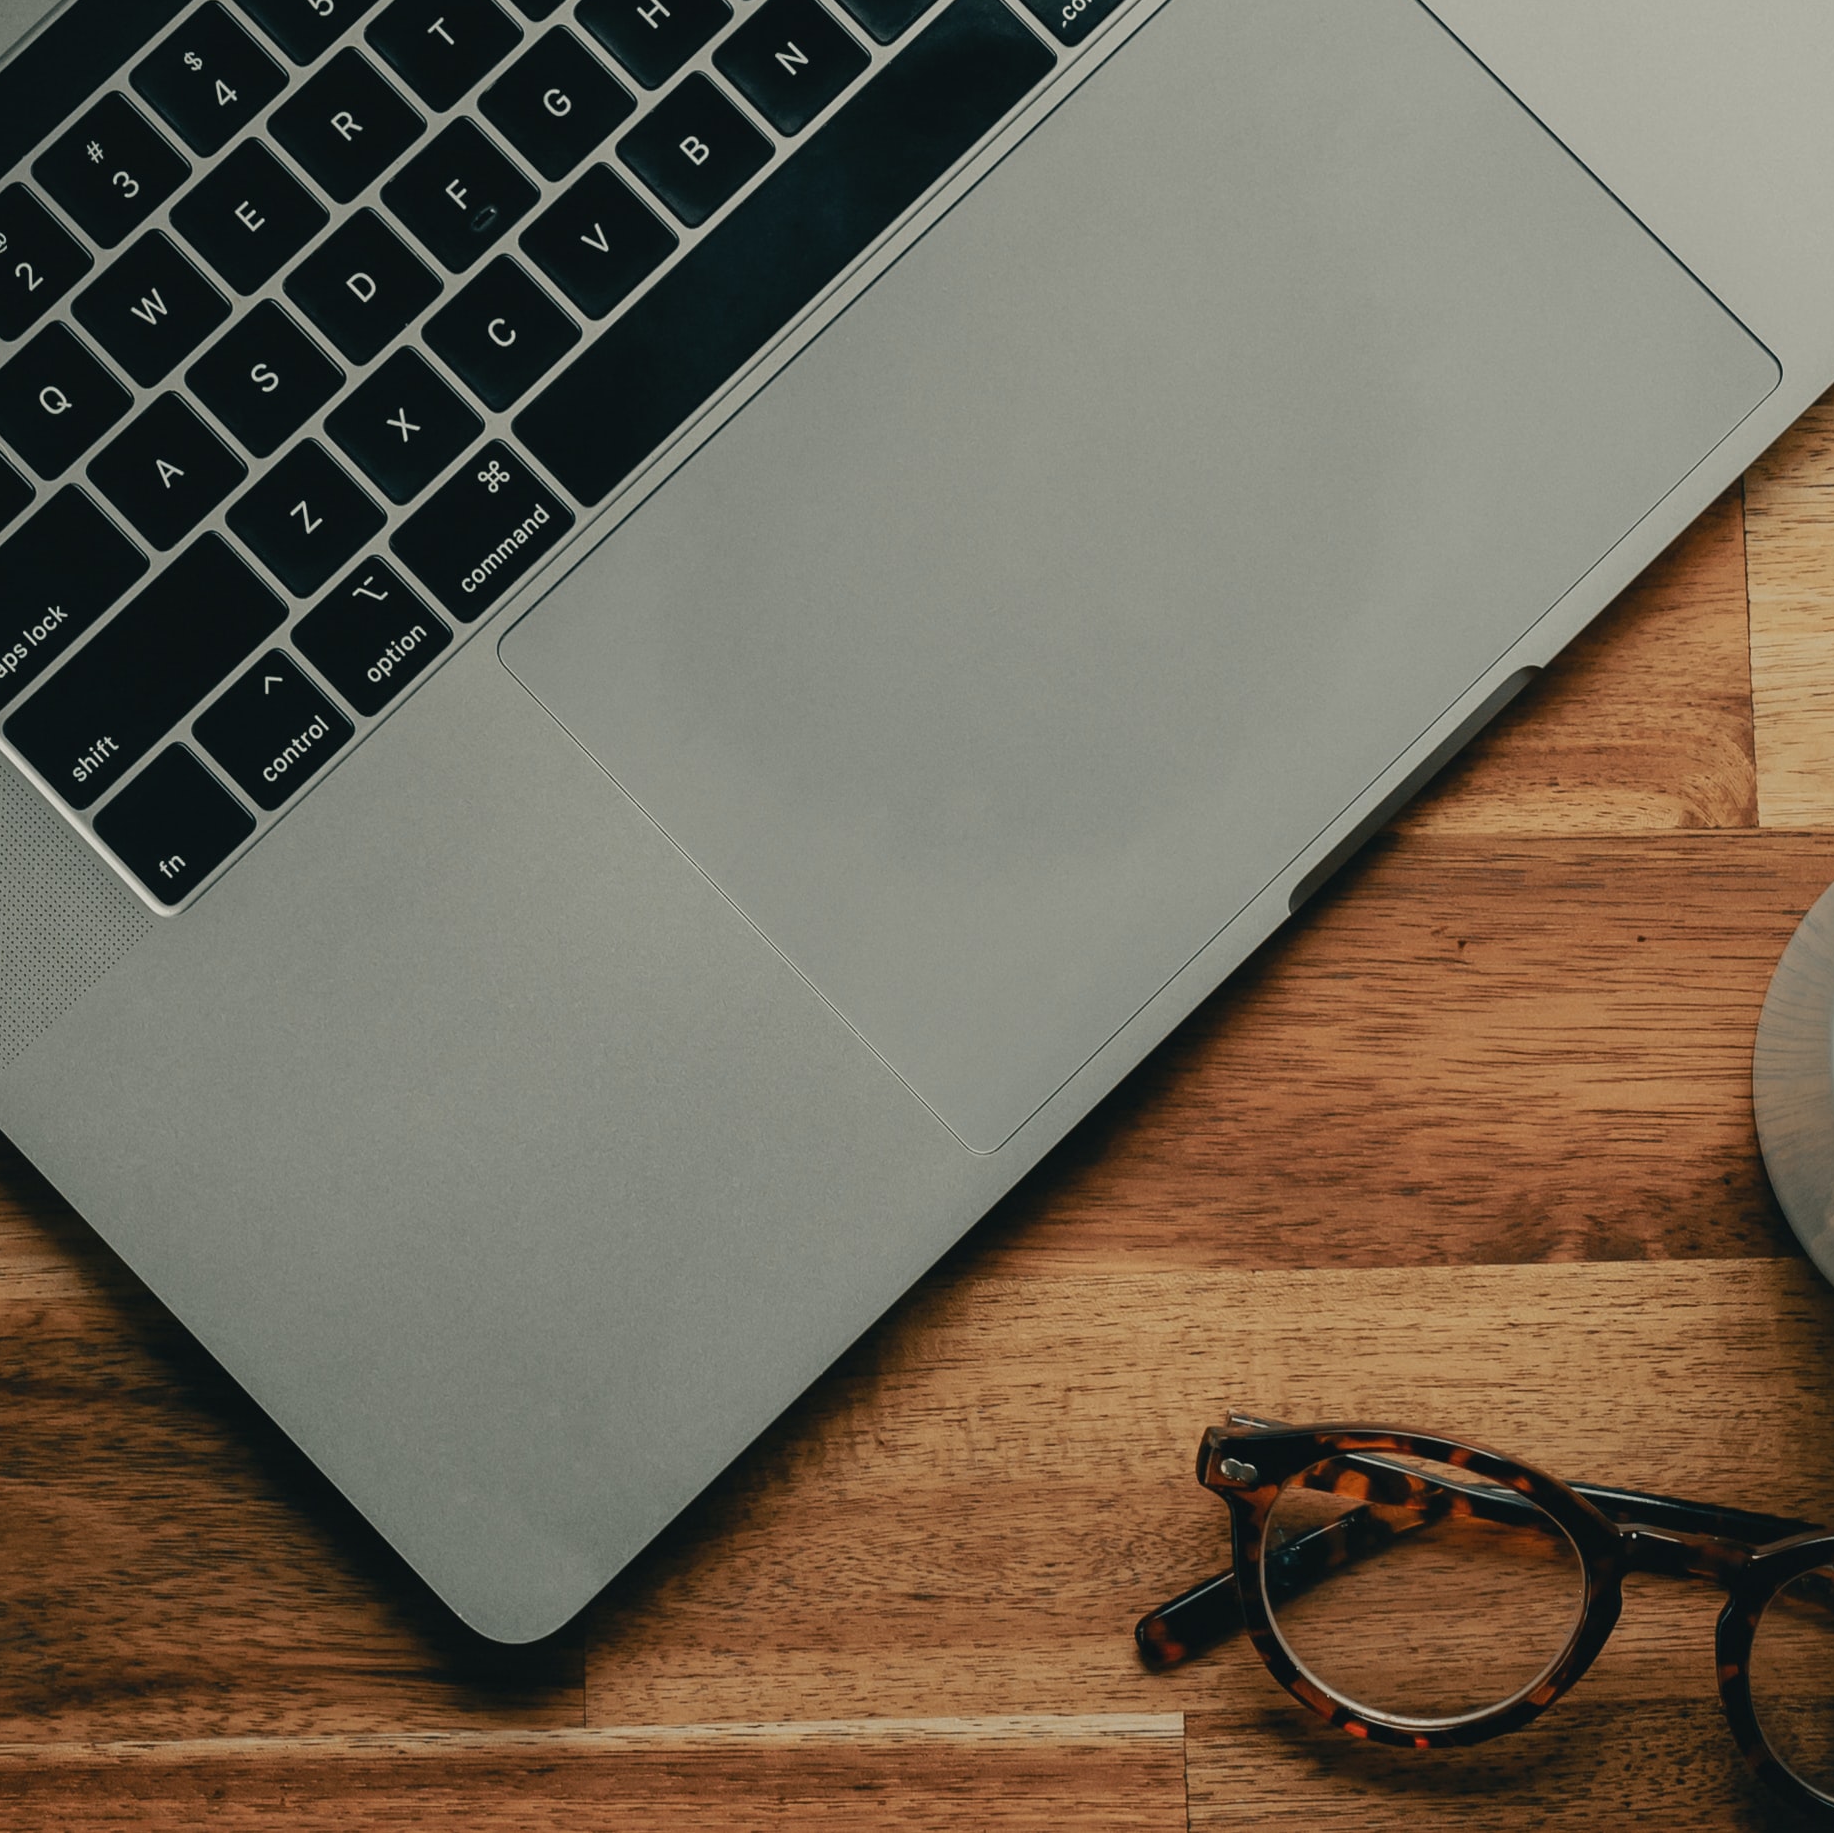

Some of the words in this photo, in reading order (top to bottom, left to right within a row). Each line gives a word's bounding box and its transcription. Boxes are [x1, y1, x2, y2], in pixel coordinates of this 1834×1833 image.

[426, 16, 455, 46] T
[183, 51, 203, 72] $
[774, 40, 810, 76] N
[214, 78, 238, 107] 4
[542, 88, 572, 117] G
[330, 111, 364, 142] R
[86, 140, 104, 164] #
[678, 135, 710, 166] B
[112, 170, 140, 199] 3
[444, 178, 468, 211] F
[234, 200, 266, 233] E
[580, 222, 610, 253] V
[14, 261, 44, 292] 2
[345, 272, 377, 303] D
[130, 287, 168, 326] W
[487, 317, 517, 348] C
[250, 362, 280, 393] S
[38, 385, 73, 415] Q
[385, 407, 422, 443] X
[155, 458, 185, 489] A
[289, 500, 324, 535] Z
[461, 502, 551, 593] command
[22, 605, 69, 647] lock
[366, 625, 428, 683] option
[72, 736, 120, 783] shift
[262, 714, 330, 783] control
[158, 855, 187, 879] fn
